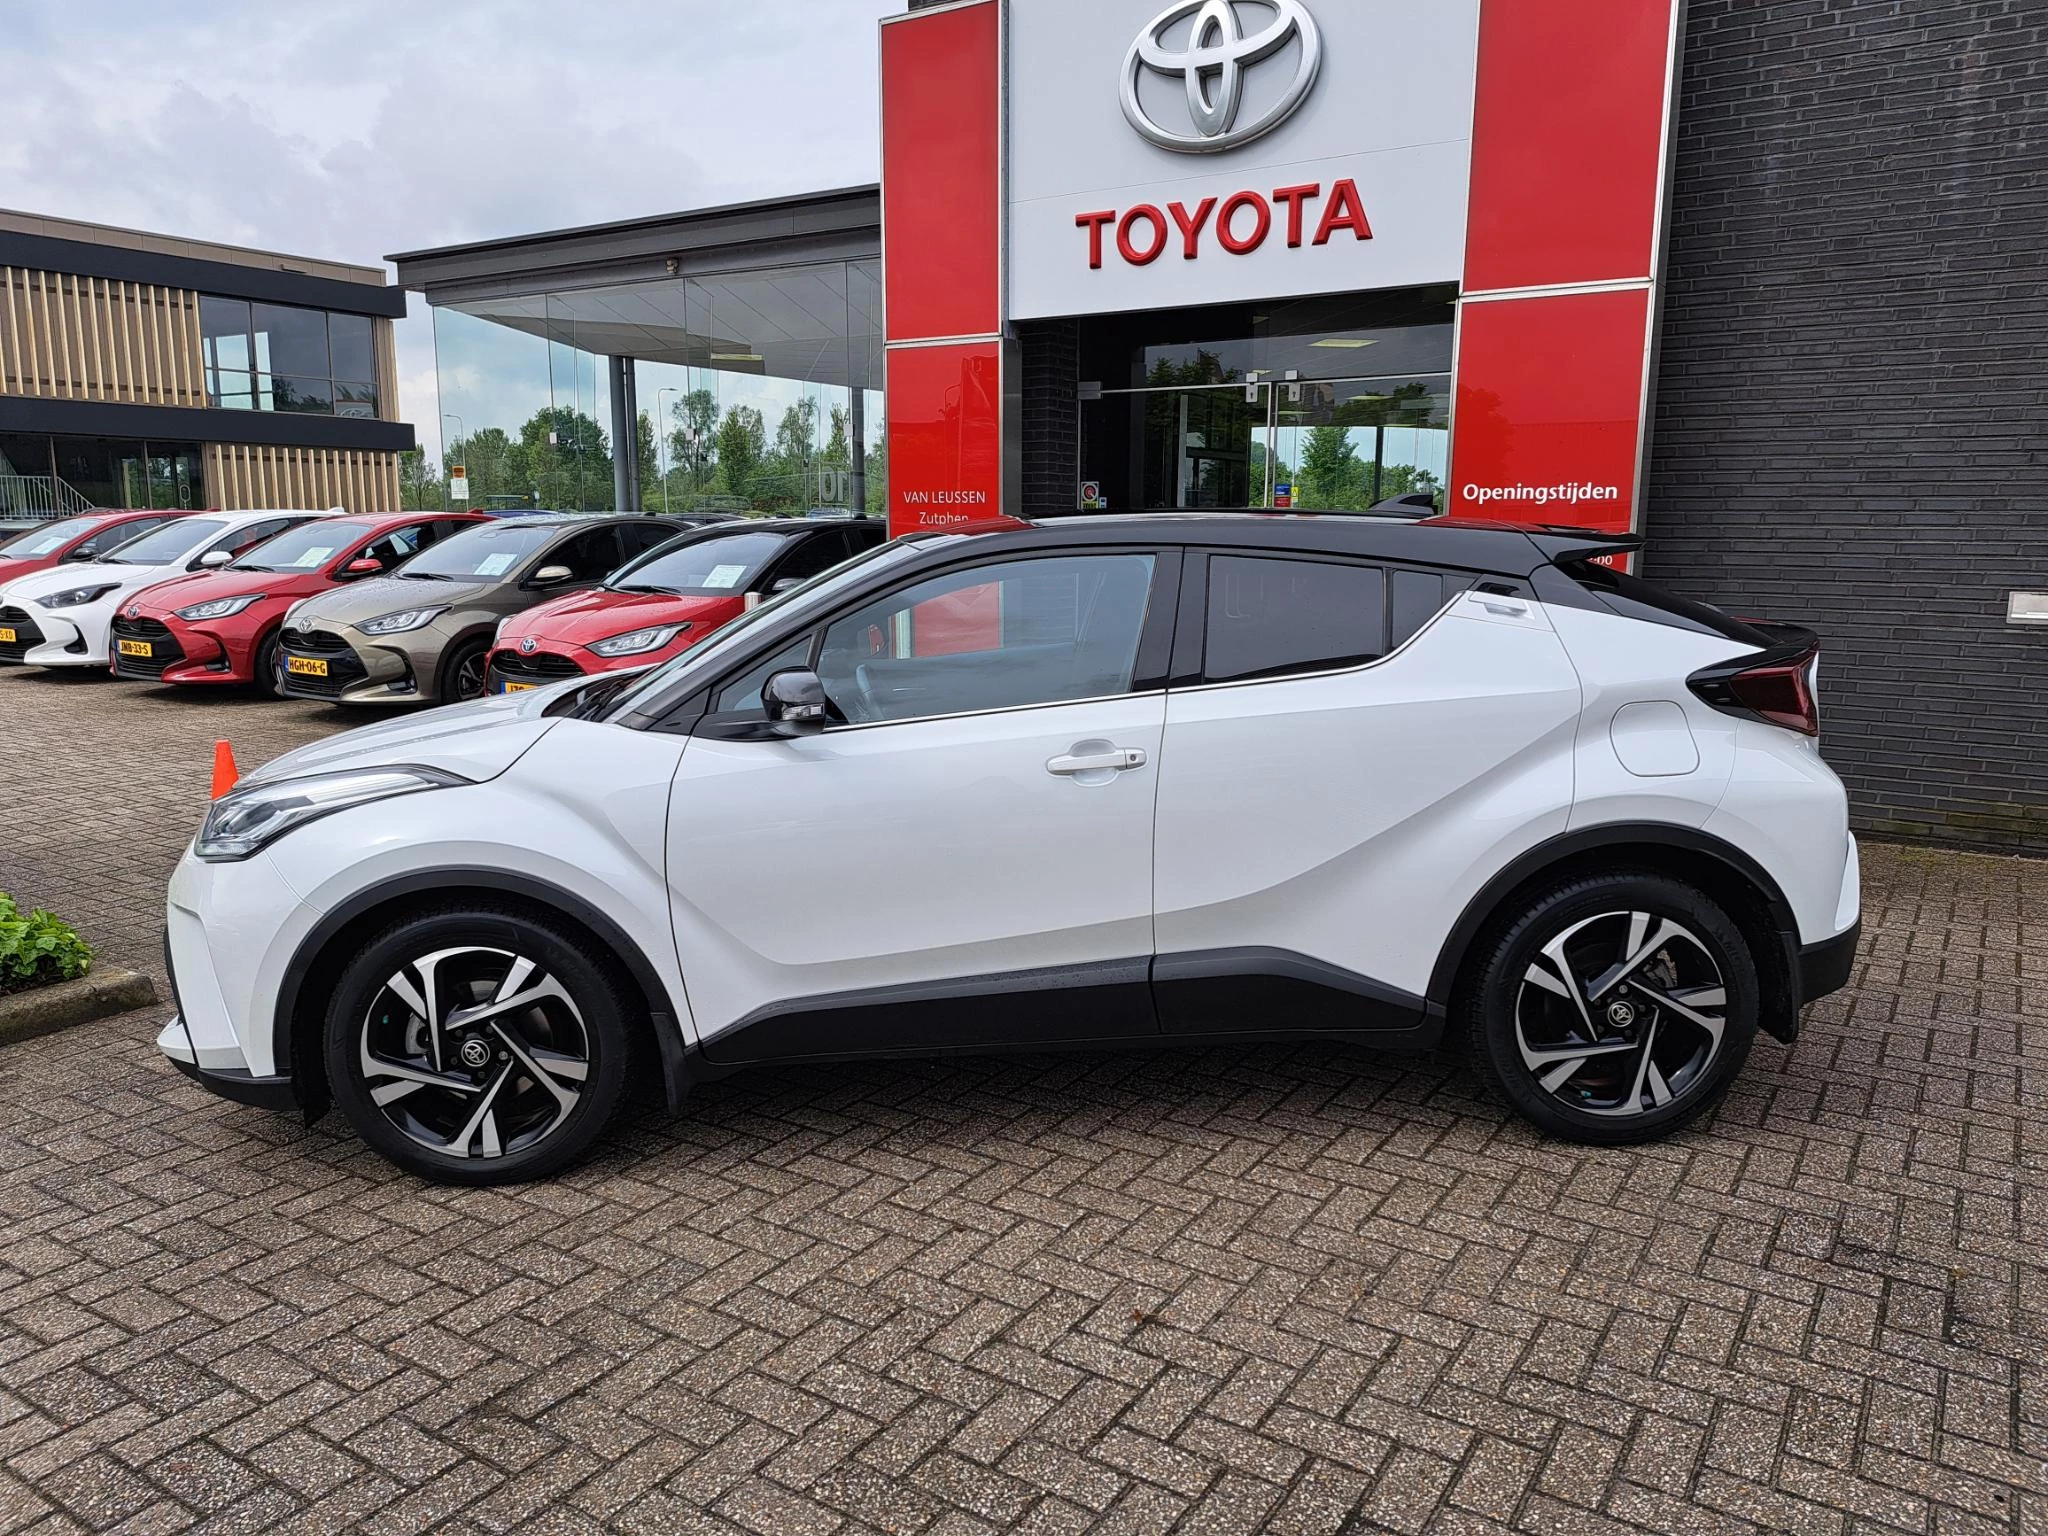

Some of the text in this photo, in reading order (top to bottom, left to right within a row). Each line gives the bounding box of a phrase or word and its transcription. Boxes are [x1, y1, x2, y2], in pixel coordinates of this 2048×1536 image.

[1075, 178, 1373, 270] TOYOTA
[903, 491, 986, 504] VAN LEUSSEN
[1463, 482, 1618, 504] Openingstijden
[289, 658, 326, 674] HGH-06-G
